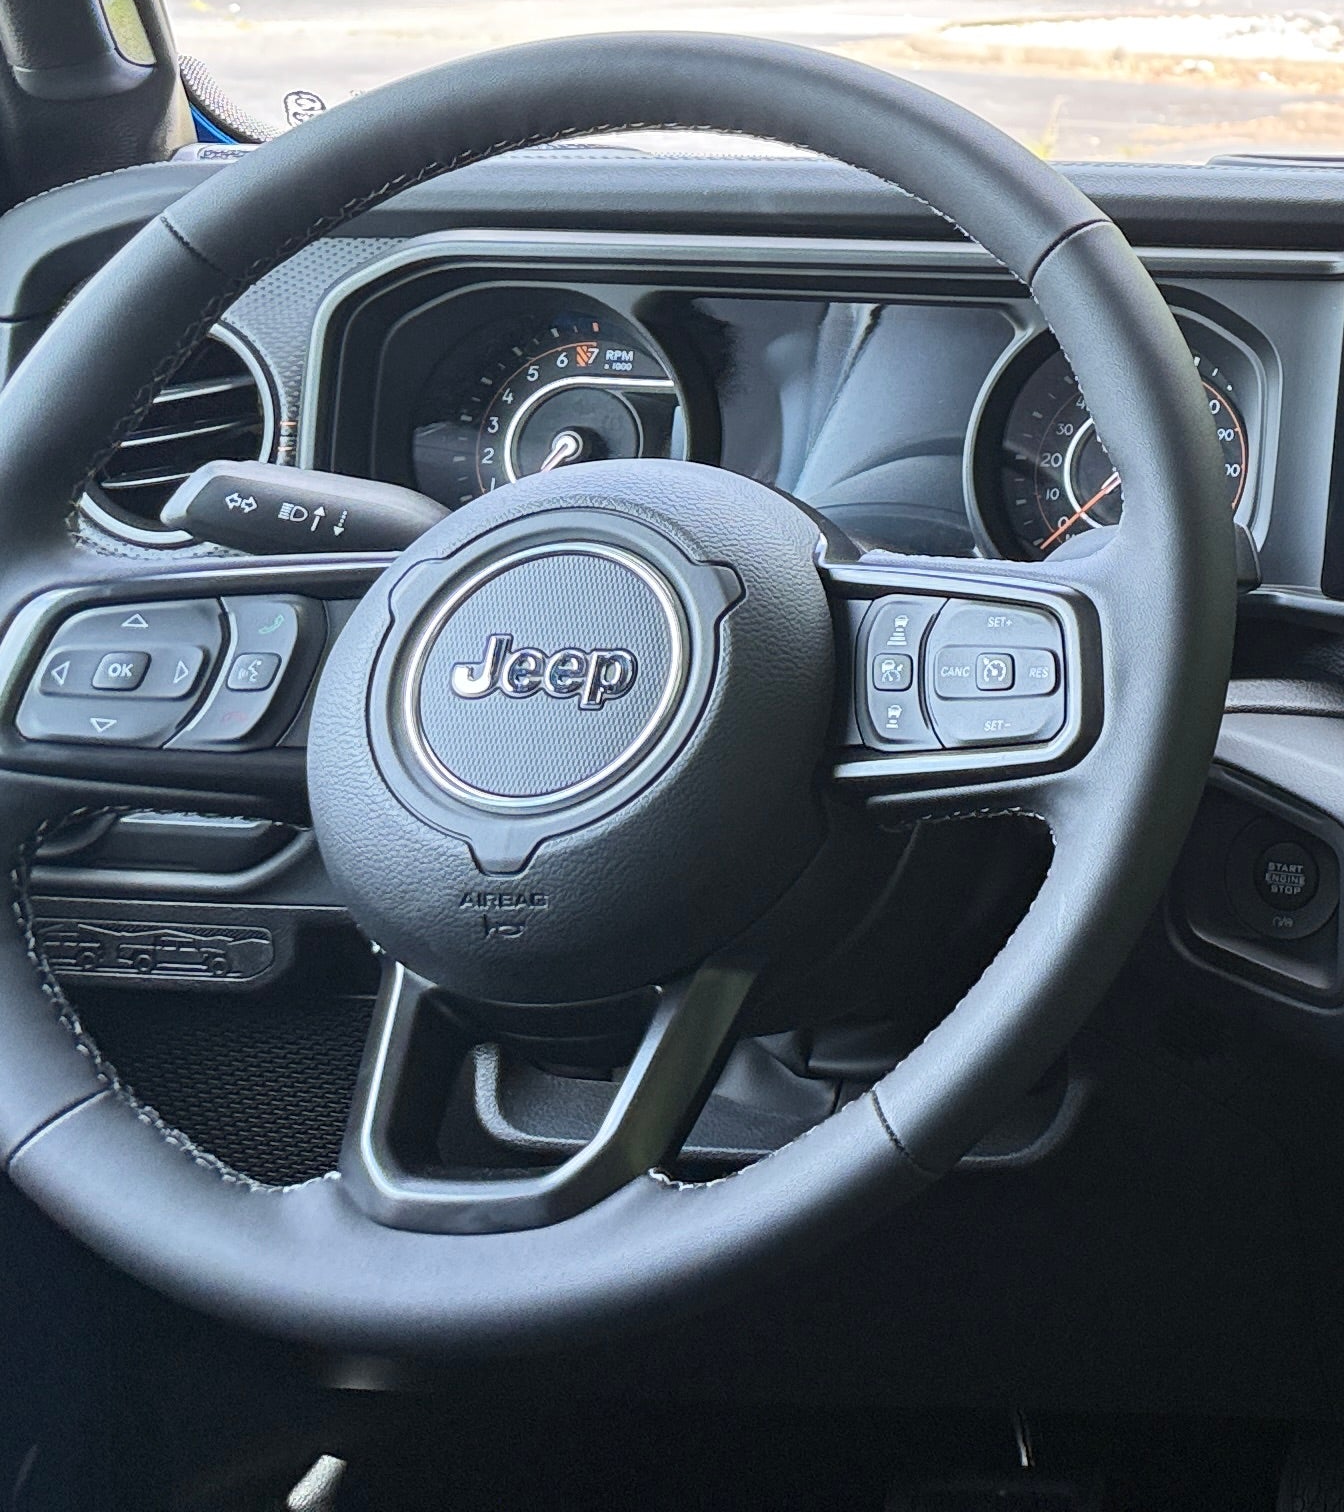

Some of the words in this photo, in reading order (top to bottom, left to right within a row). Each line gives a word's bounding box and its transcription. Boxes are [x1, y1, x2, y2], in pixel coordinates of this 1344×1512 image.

[557, 352, 569, 368] 6
[587, 348, 600, 364] 7
[606, 350, 634, 362] RPM
[527, 366, 539, 382] 5
[502, 389, 513, 404] 4
[1209, 399, 1220, 414] 0
[487, 417, 499, 434] 3
[1056, 423, 1073, 436] 30
[1217, 429, 1234, 441] 90
[482, 448, 495, 464] 2
[1040, 453, 1063, 468] 20
[1046, 488, 1060, 501] 10
[108, 663, 133, 678] OK
[451, 633, 638, 710] Jeep
[940, 667, 970, 677] CANC
[1029, 668, 1048, 678] RES
[1268, 862, 1303, 872] START
[1265, 874, 1305, 885] ENGINE
[1271, 886, 1300, 895] STOP
[459, 892, 549, 909] AIRBAG
